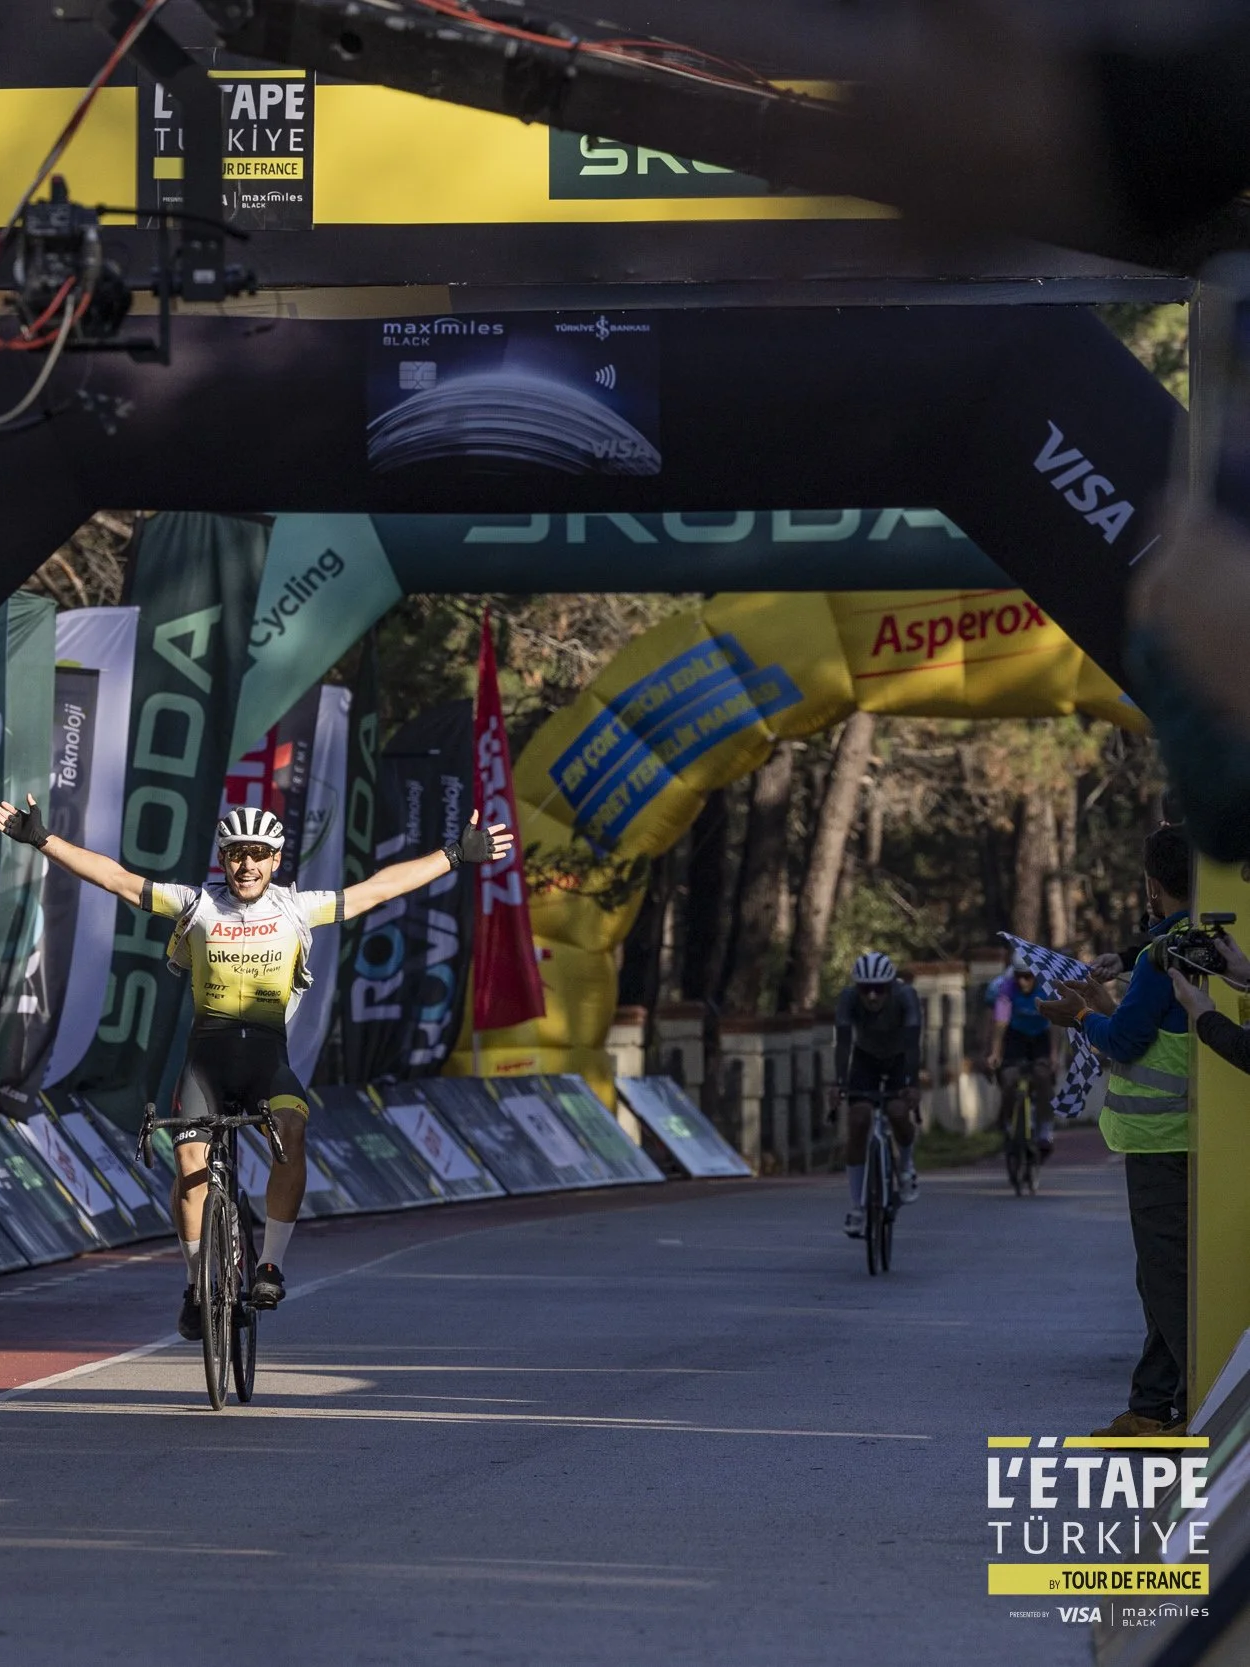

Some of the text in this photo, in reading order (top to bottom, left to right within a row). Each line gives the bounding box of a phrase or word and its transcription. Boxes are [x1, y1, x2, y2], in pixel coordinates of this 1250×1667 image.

[237, 162, 251, 175] DE
[254, 162, 298, 175] FRANCE
[241, 191, 303, 202] maximiles
[383, 317, 504, 335] maximiles
[555, 323, 650, 332] TÜRKİYE BANKASI
[383, 337, 430, 346] BLACK
[1032, 419, 1136, 545] VISA
[870, 600, 1048, 658] Asperox
[57, 703, 87, 789] Teknoloji
[210, 921, 279, 940] Asperox
[208, 950, 282, 965] bikepedia
